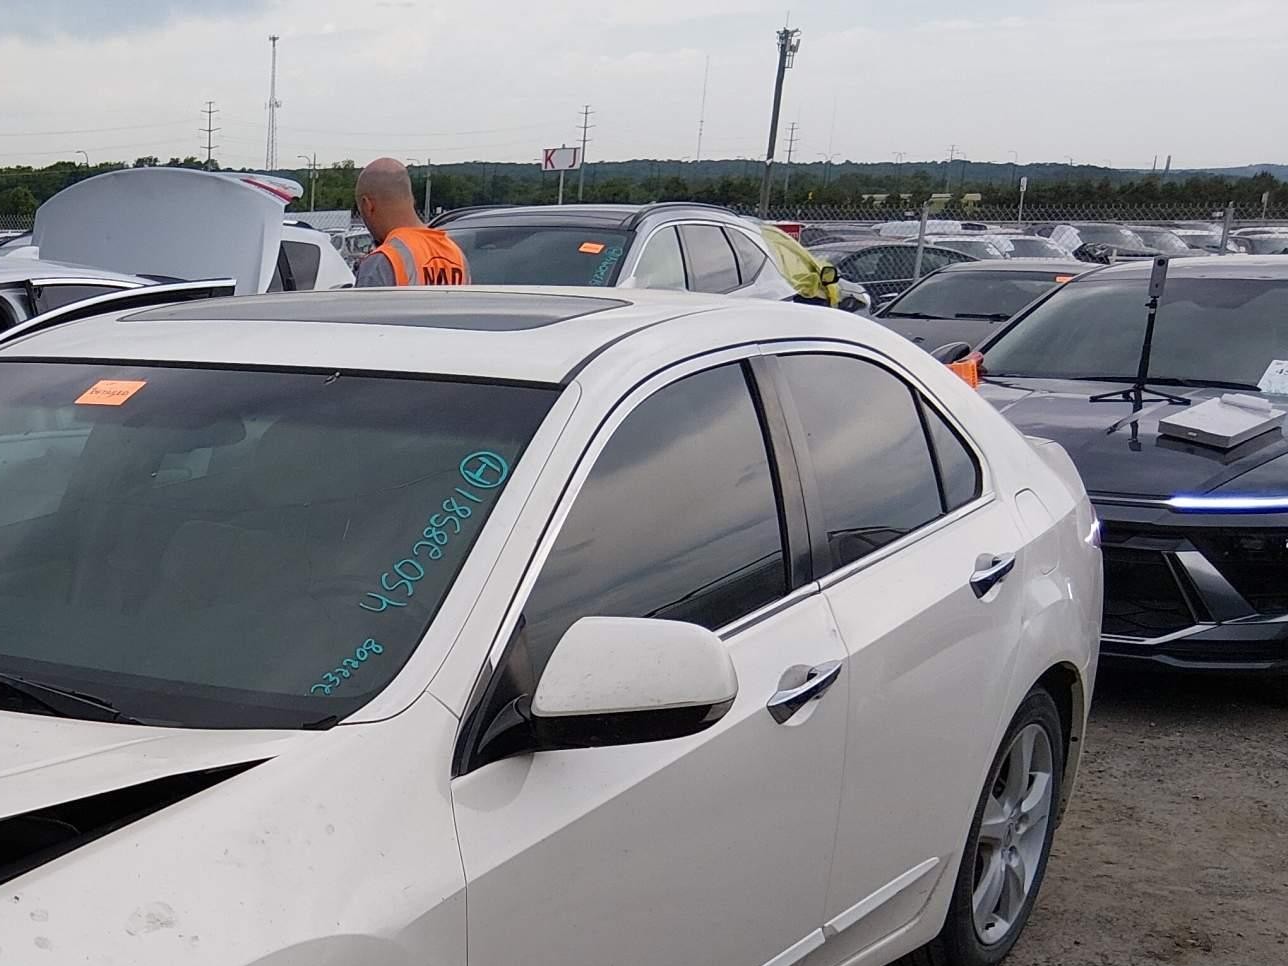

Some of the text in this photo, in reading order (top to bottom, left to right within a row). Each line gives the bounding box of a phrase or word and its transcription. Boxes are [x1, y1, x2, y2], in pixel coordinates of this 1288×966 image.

[544, 148, 577, 169] K J
[360, 488, 483, 612] 45028581
